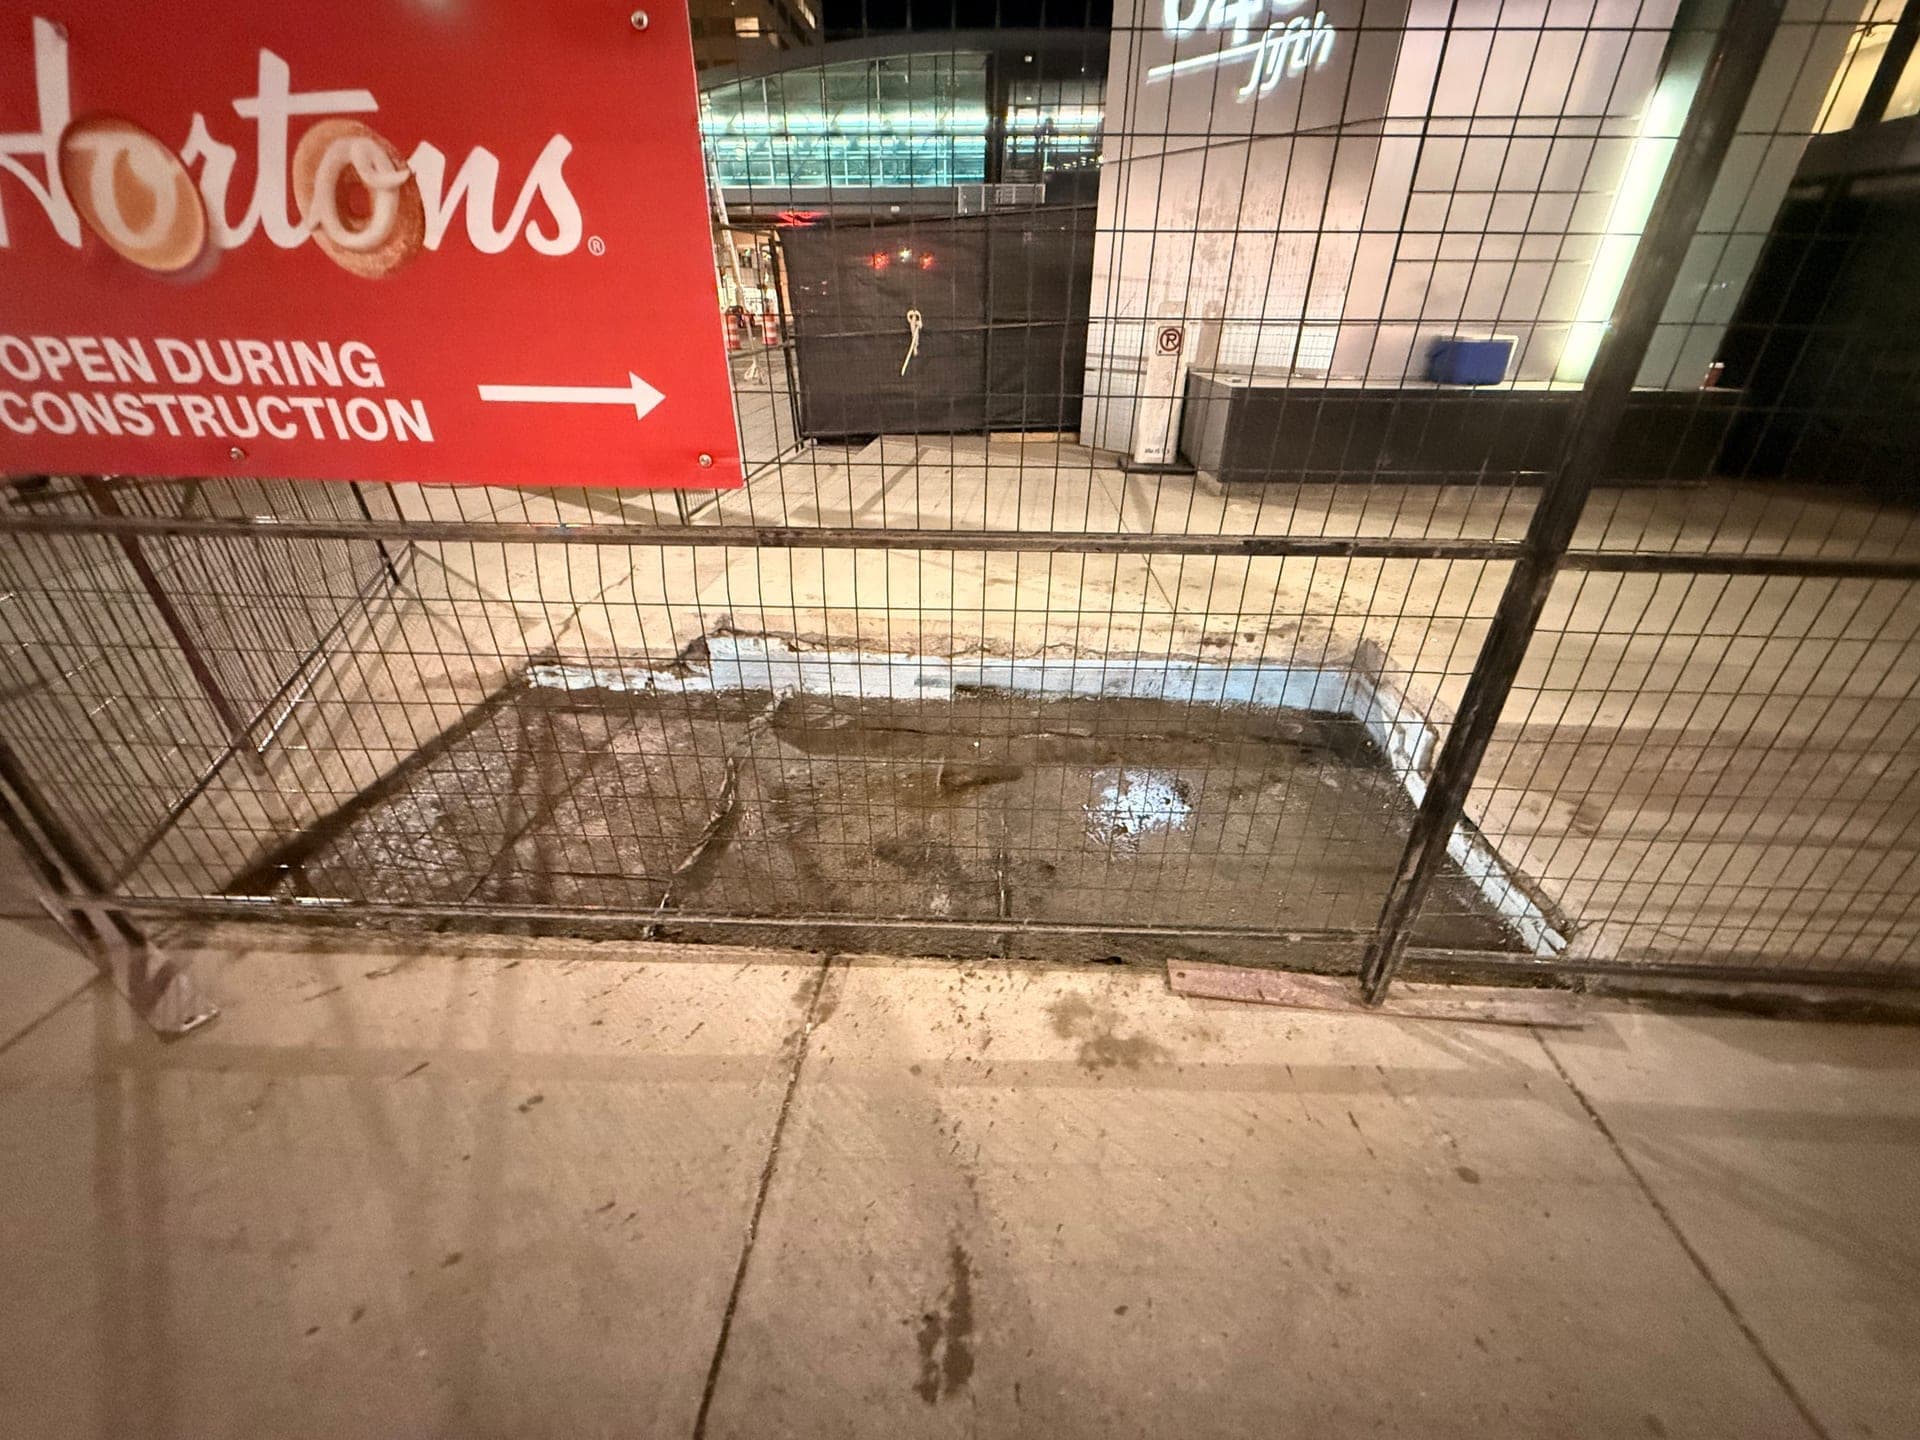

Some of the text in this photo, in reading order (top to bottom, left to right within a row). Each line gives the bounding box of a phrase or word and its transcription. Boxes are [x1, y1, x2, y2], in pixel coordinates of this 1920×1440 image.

[0, 335, 385, 388] OPEN DURING
[0, 391, 434, 443] CONSTRUCTION
